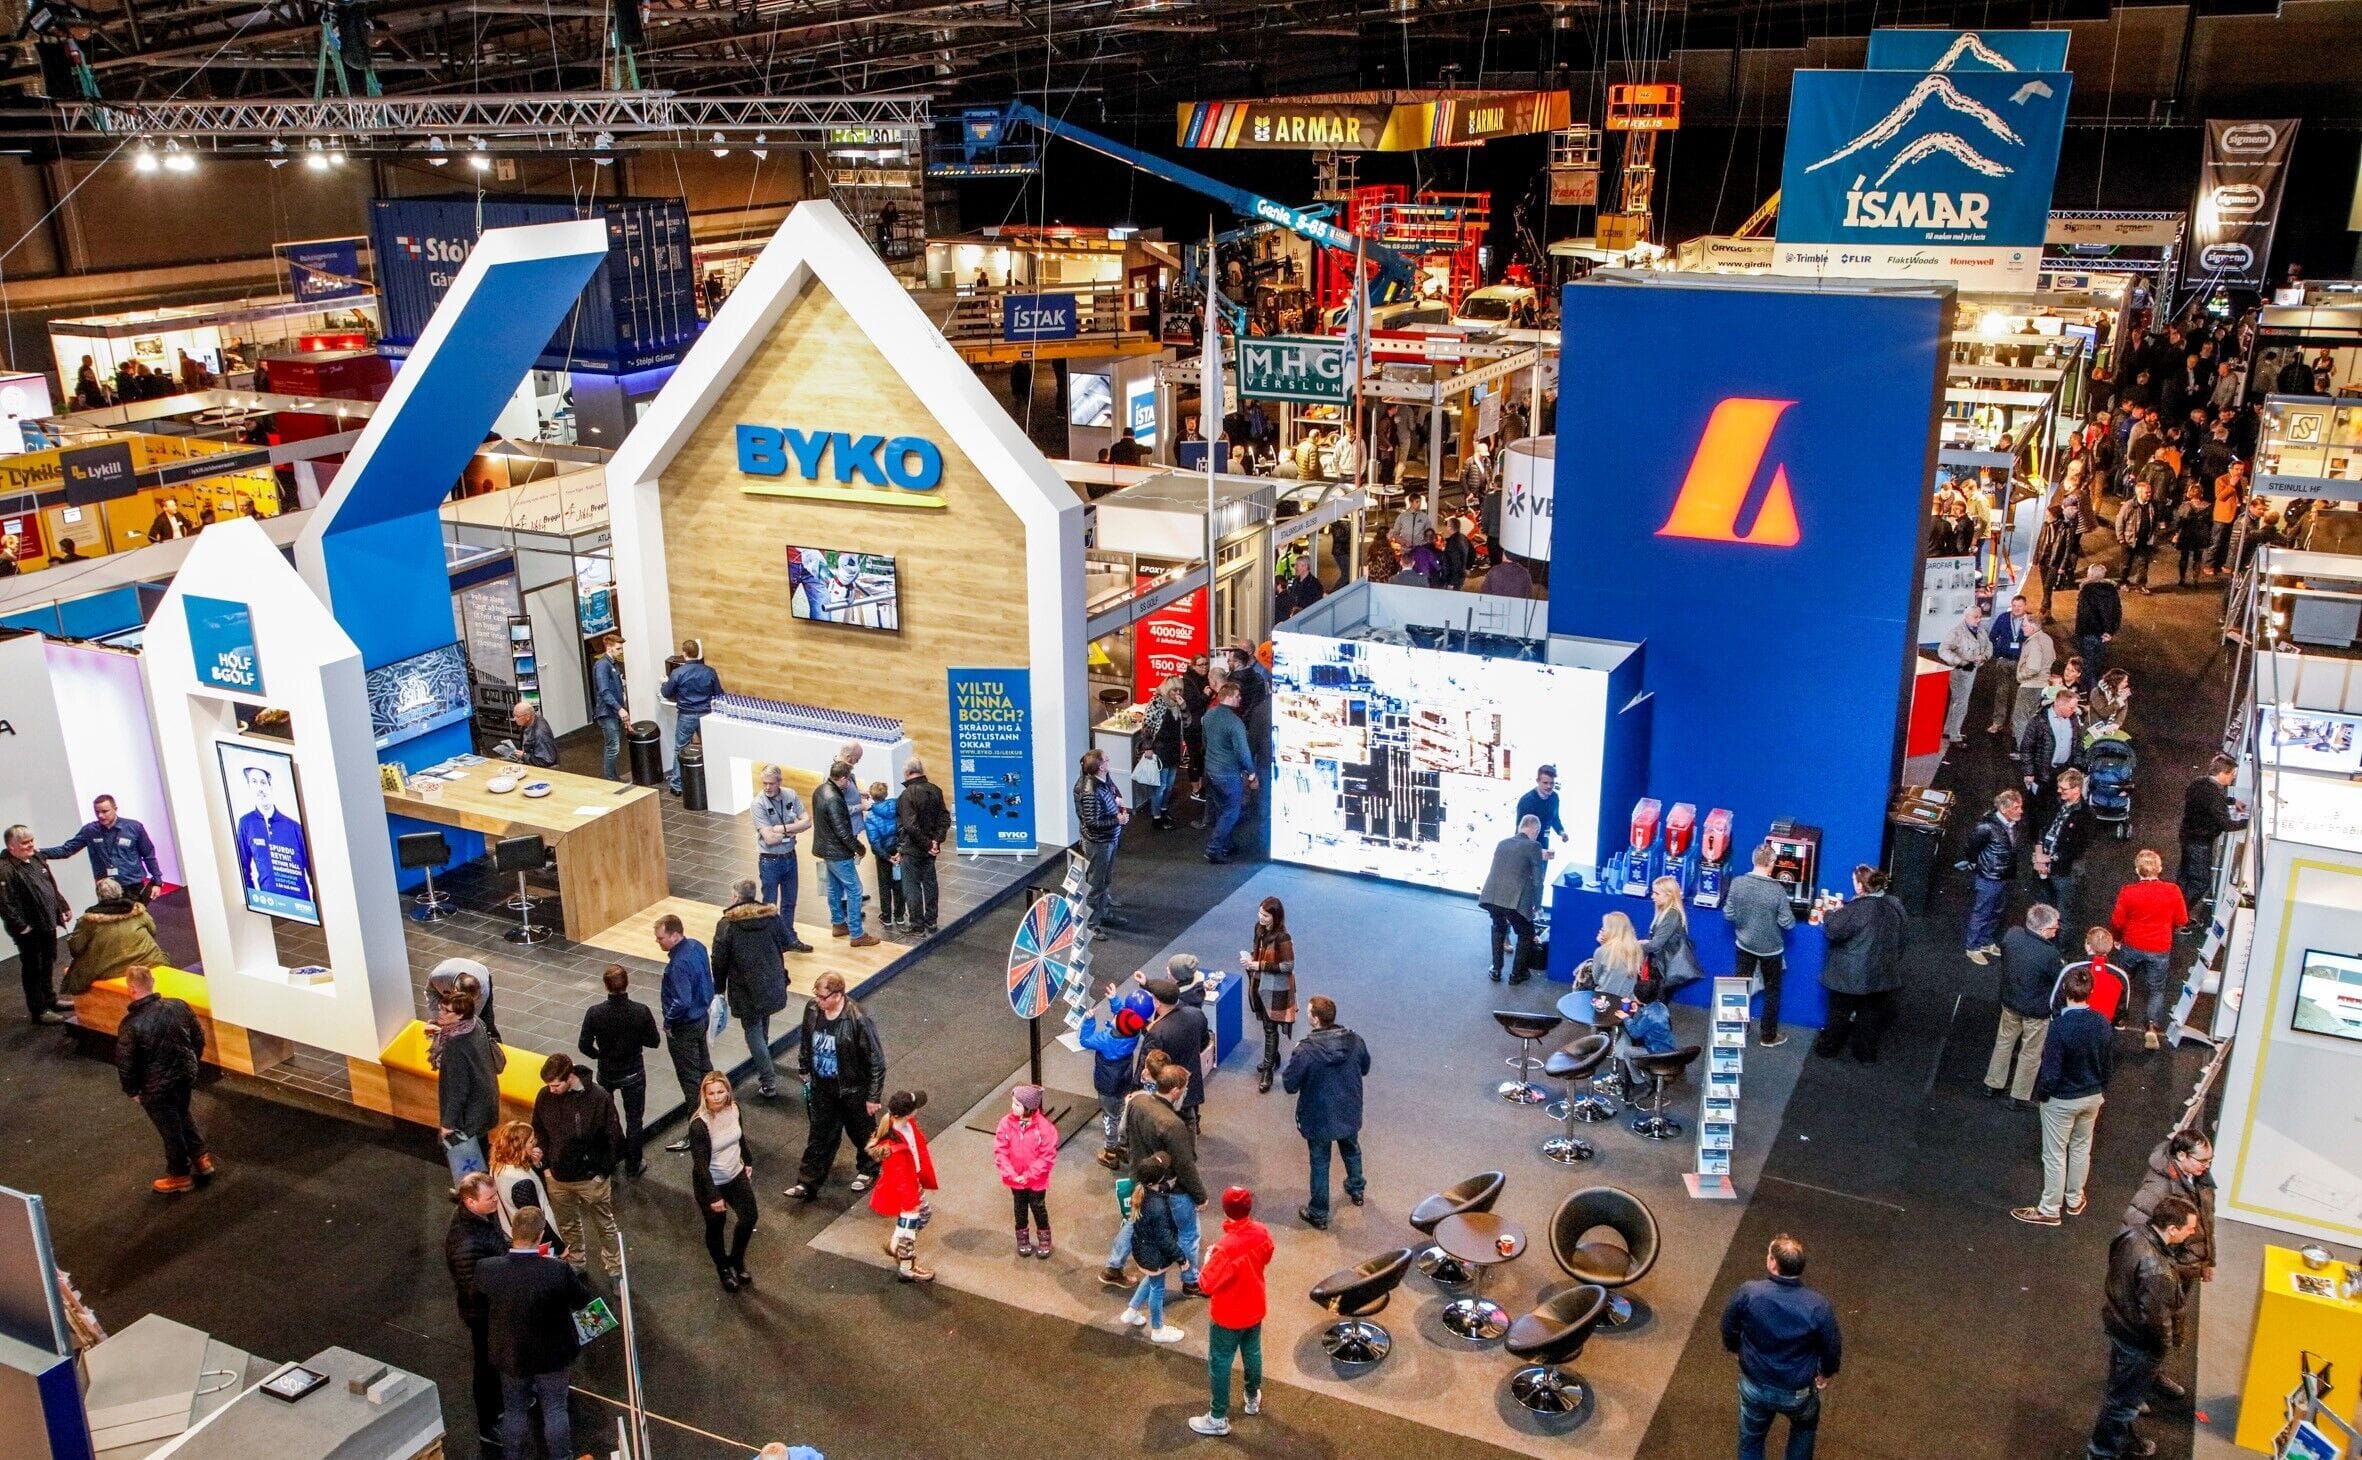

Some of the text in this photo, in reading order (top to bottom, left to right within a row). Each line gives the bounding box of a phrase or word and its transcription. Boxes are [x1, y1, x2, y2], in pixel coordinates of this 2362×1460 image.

[1475, 107, 1504, 133] ARMAR
[1275, 116, 1361, 143] ARMAR
[2228, 133, 2269, 146] sigmenn
[1843, 174, 1990, 229] ÍSMAR
[2217, 193, 2257, 206] sigmenn
[1255, 199, 1292, 225] Genie
[1295, 214, 1328, 238] S-65
[2063, 222, 2154, 234] sigmenn sigmenn
[425, 237, 474, 262] Stólp
[1796, 253, 1829, 263] Trimble
[1849, 255, 1872, 263] FLIR
[1950, 257, 1995, 267] Honeywell
[1013, 305, 1067, 328] ÍSTAK
[1246, 348, 1341, 379] MHG
[1246, 377, 1341, 393] VERSLUN
[736, 424, 944, 491] BYKO
[87, 462, 122, 480] Lykill
[2268, 482, 2322, 494] STEINULL HF
[1139, 565, 1165, 574] EPOXY
[1149, 625, 1176, 637] 4000
[1150, 659, 1175, 671] 1500
[956, 682, 1004, 695] VILTU
[957, 695, 1013, 709] VINNA
[959, 708, 1025, 722] BOSCH?
[958, 722, 1022, 732] SKRÁÐU ÞIG Á
[959, 731, 1020, 741] PÓSTLISTANN
[959, 741, 992, 749] OKKAR
